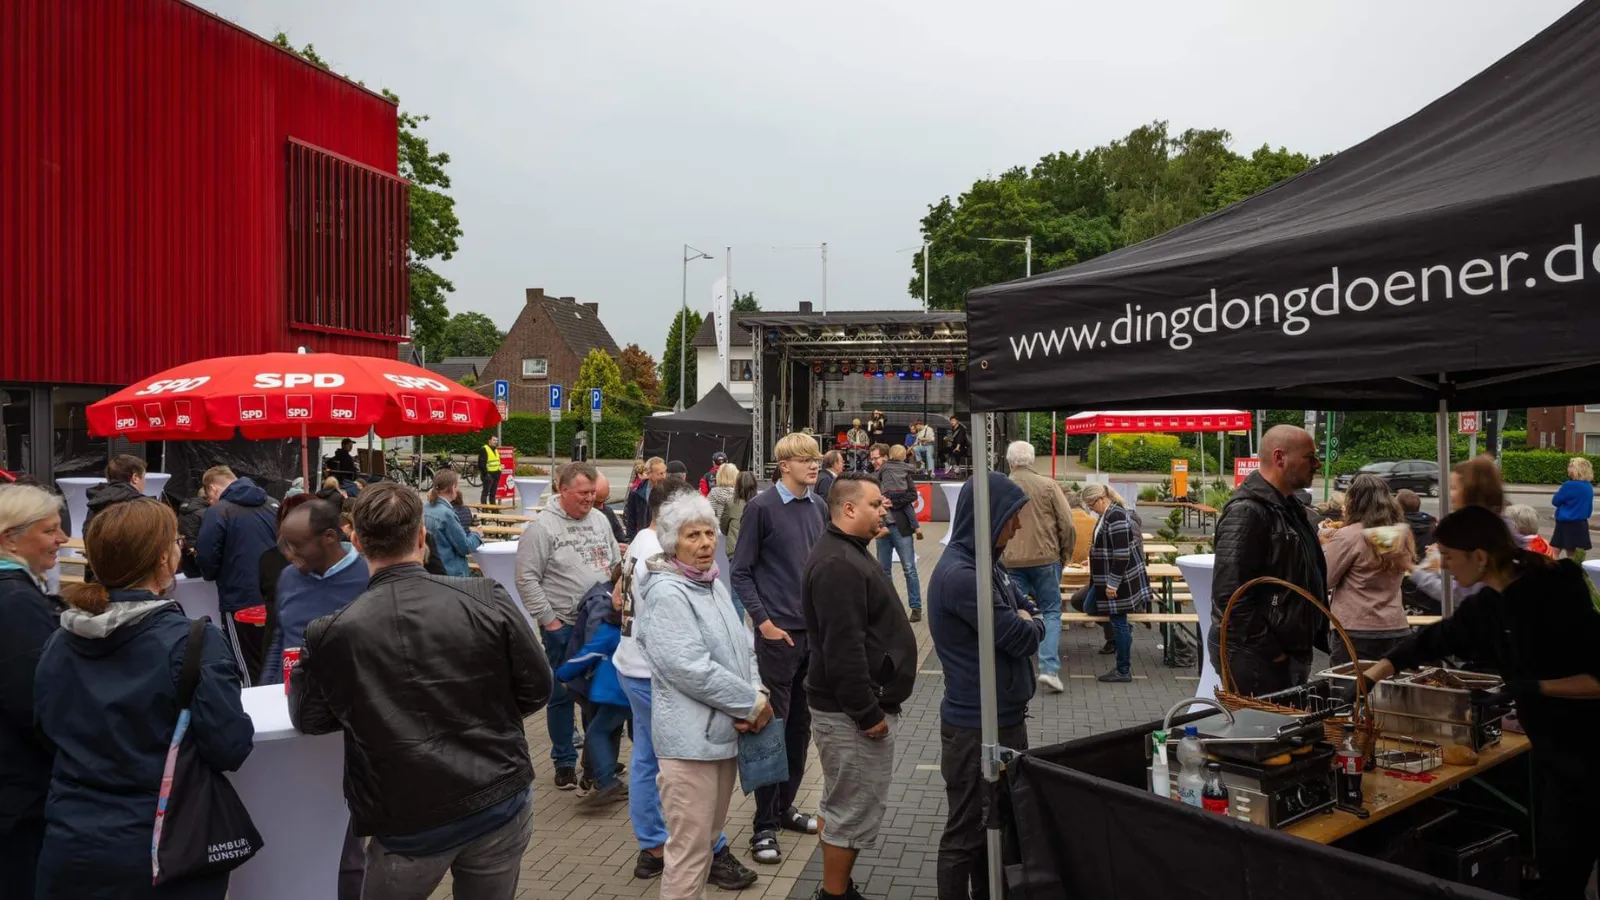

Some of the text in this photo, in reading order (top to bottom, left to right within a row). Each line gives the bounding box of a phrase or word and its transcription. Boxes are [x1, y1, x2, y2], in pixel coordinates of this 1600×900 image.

[1009, 223, 1600, 361] www.dingdongdoener.d
[135, 376, 211, 396] SPD
[253, 373, 345, 389] SPD
[383, 373, 450, 392] SPD
[552, 388, 559, 406] P
[593, 391, 600, 407] P
[242, 410, 263, 419] SPD
[288, 408, 308, 417] SPD
[332, 409, 353, 418] SPD
[431, 410, 445, 419] SPD
[452, 413, 468, 421] SPD
[117, 418, 135, 428] SPD
[149, 417, 162, 426] PD
[177, 415, 191, 424] SPD
[1463, 418, 1475, 430] SPD
